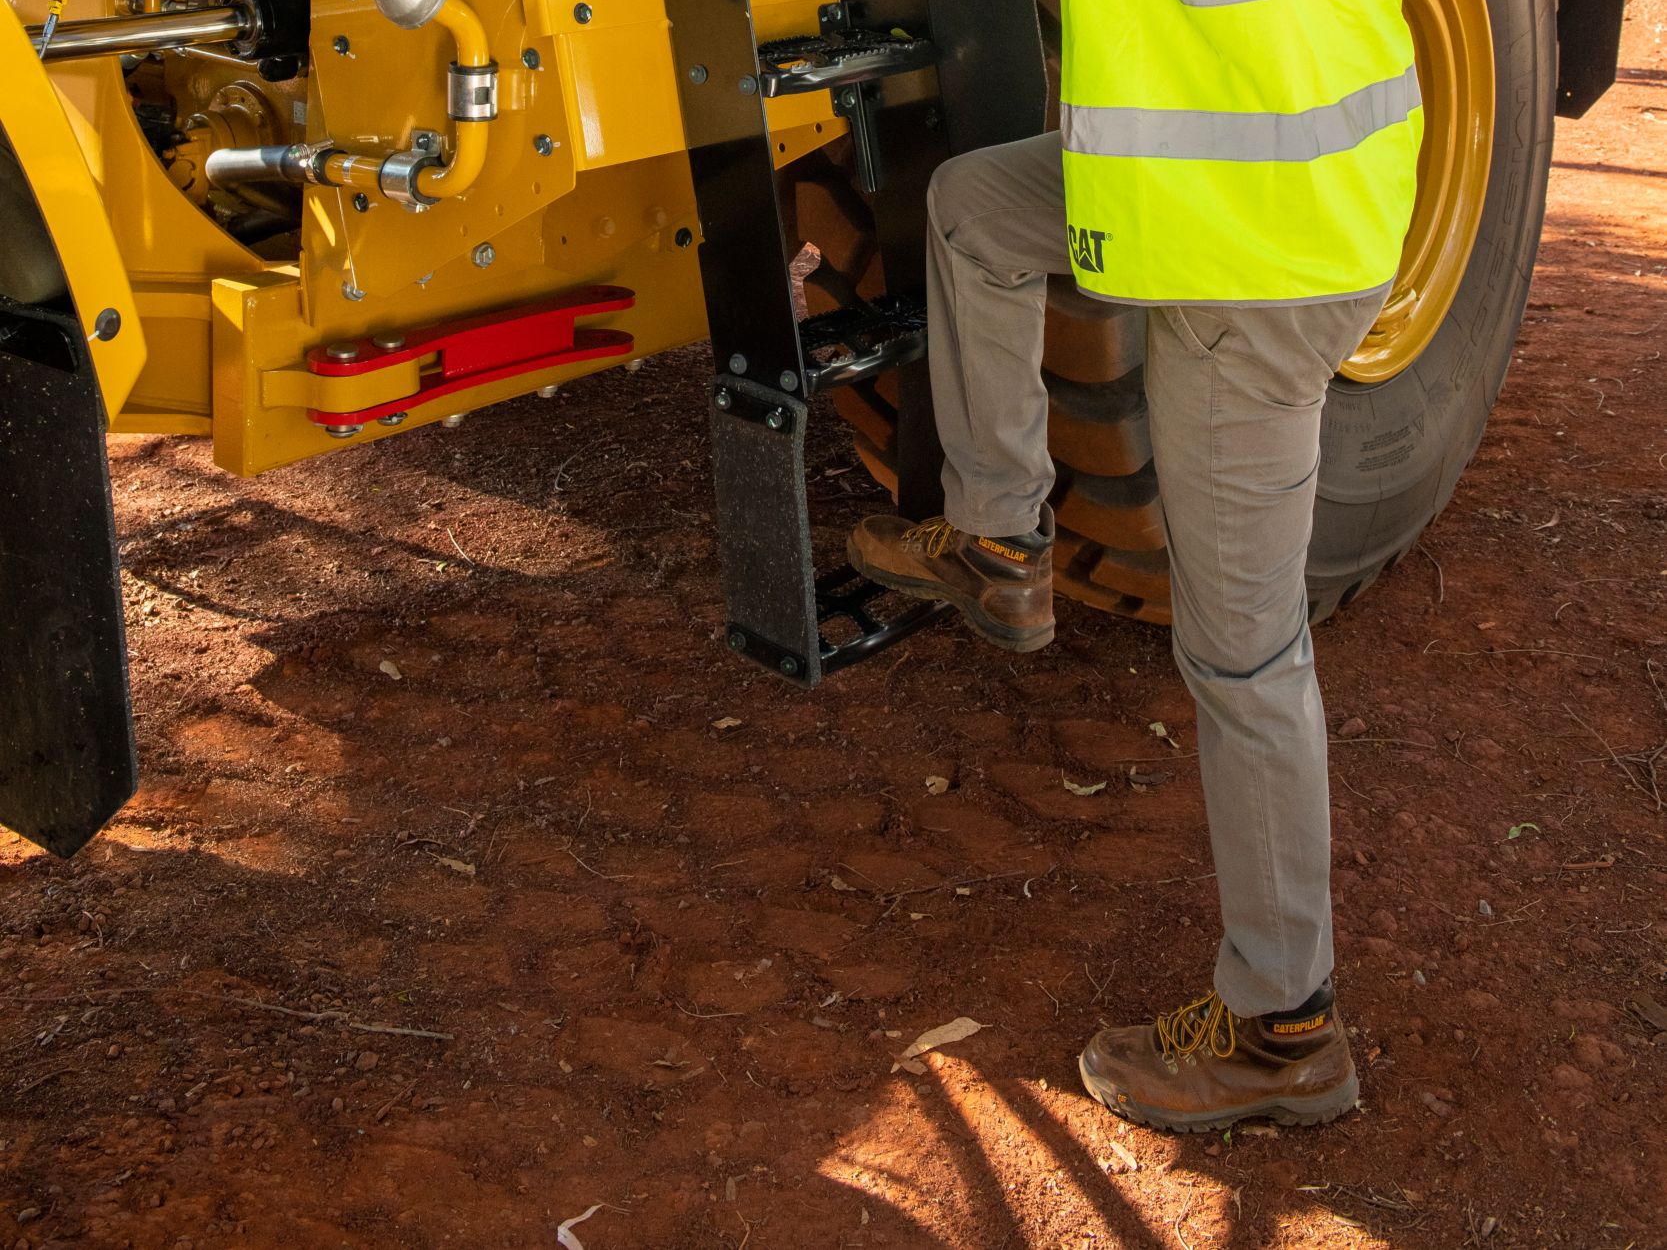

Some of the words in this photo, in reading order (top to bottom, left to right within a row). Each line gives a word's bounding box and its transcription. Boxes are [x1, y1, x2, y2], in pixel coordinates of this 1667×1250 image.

[1068, 224, 1105, 273] CAT
[978, 536, 1025, 562] CATERPILLAR
[1273, 1014, 1324, 1033] CATERPILLAR
